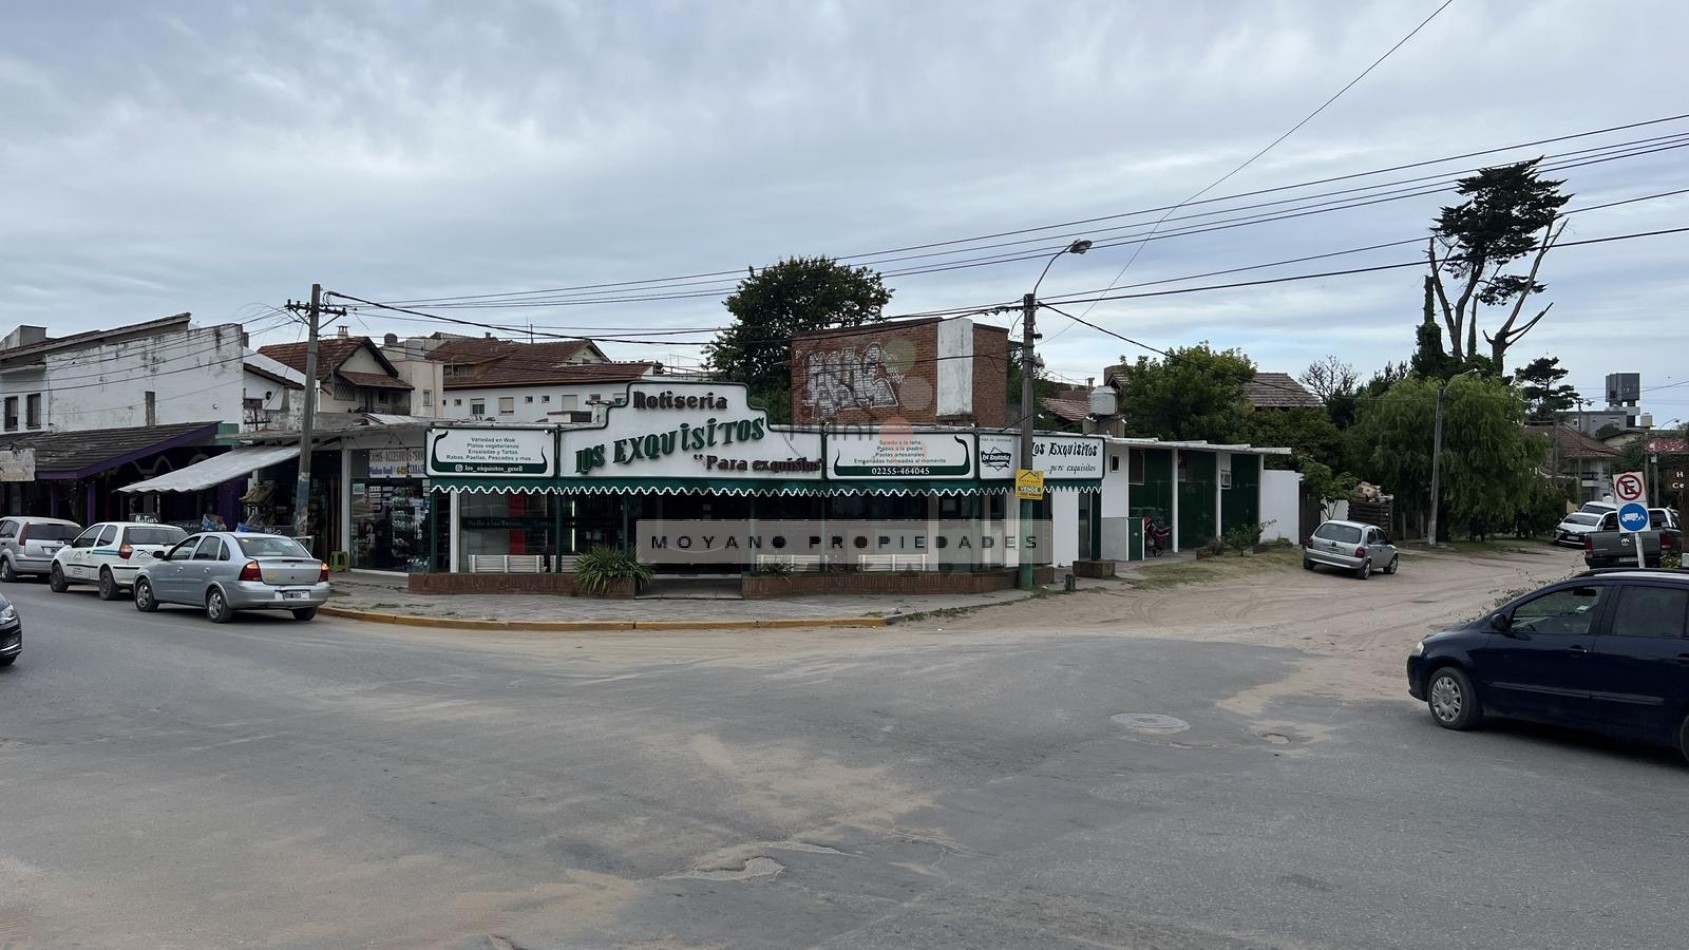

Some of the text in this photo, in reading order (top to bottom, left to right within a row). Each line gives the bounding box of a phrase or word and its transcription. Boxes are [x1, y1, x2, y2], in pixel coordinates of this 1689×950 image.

[633, 390, 728, 410] Rotiseria
[575, 443, 606, 475] LOS
[871, 467, 930, 475] 02255-464045
